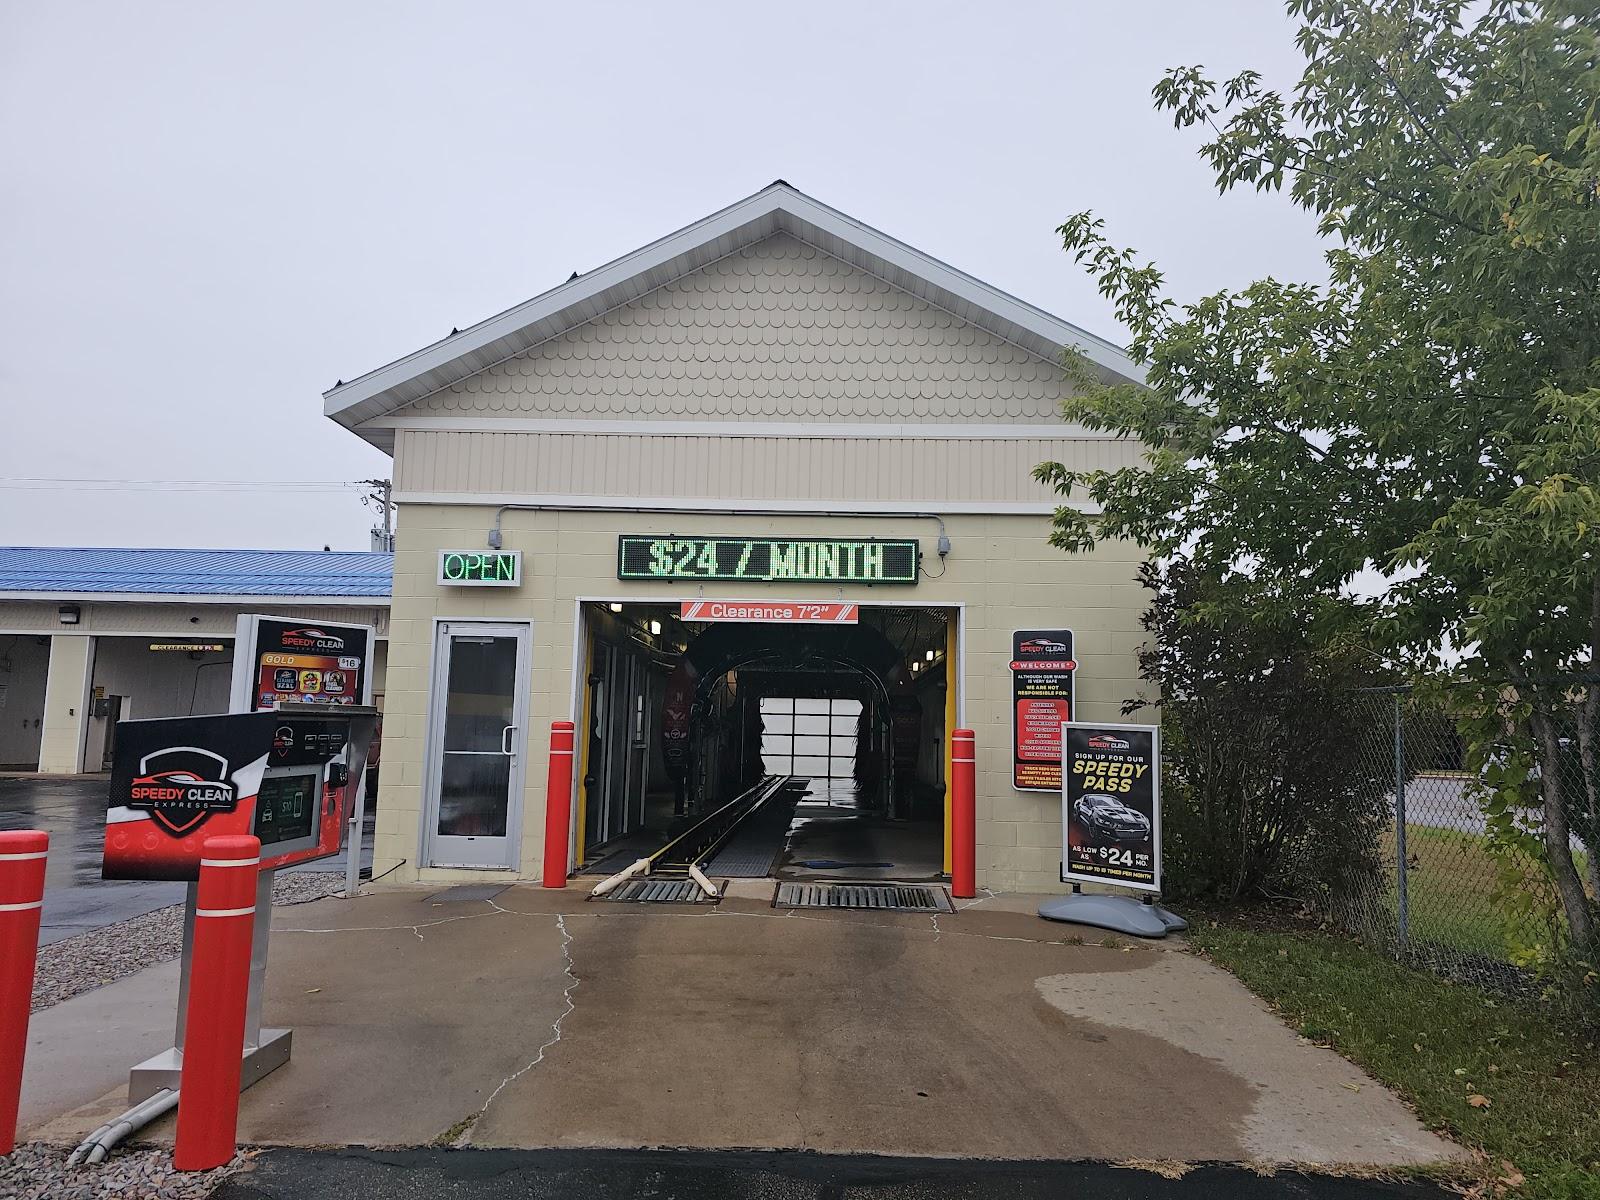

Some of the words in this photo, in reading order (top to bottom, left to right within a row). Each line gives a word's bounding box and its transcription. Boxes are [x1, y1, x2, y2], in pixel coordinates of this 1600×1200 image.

[649, 540, 718, 575] $24
[769, 542, 883, 578] MONTH
[445, 554, 513, 580] OPEN
[711, 603, 793, 619] Clearance
[281, 637, 315, 647] SPEEDY
[316, 640, 344, 649] CLEAN
[265, 655, 295, 665] GOLD
[341, 658, 356, 668] $16
[1074, 752, 1093, 760] SIGN
[1072, 759, 1149, 779] SPEEDY
[1082, 775, 1133, 793] PASS
[131, 787, 186, 800] SPEEDY
[187, 789, 233, 802] CLEAN
[1100, 846, 1133, 867] $24
[1135, 853, 1149, 861] PER
[1133, 872, 1152, 880] MONTH
